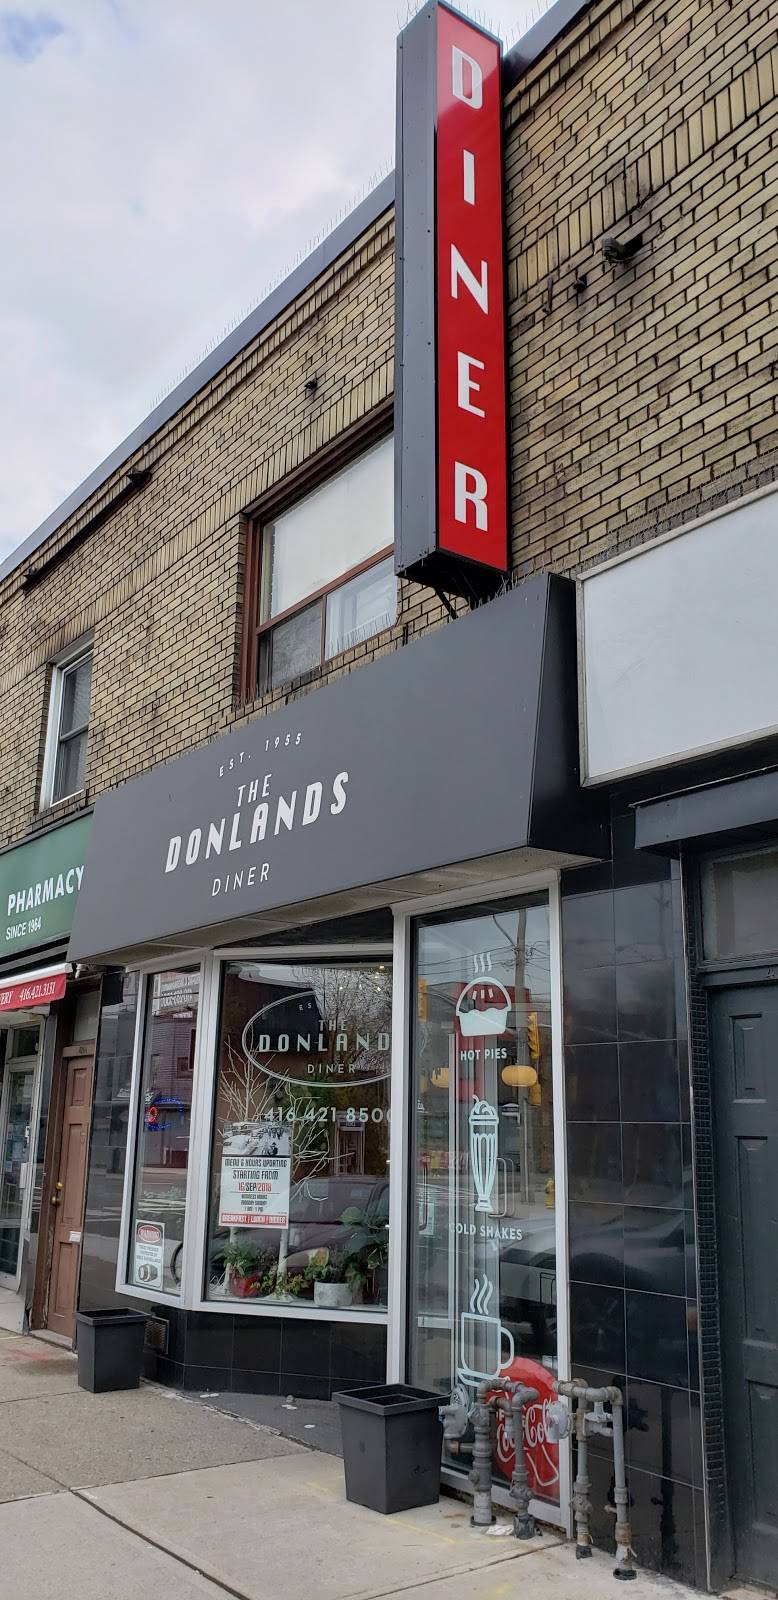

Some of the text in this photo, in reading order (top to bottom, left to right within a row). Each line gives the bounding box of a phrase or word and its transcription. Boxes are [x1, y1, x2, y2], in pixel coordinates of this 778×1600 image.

[449, 44, 489, 533] DINER
[219, 732, 302, 777] EST. 1955
[237, 773, 272, 807] THE
[164, 771, 349, 873] DONLANDS
[211, 862, 270, 897] DINER
[7, 865, 85, 916] PHARMACY
[5, 916, 42, 941] SINCE 1964
[0, 990, 14, 1005] ERY
[318, 1019, 348, 1032] THE
[460, 1048, 507, 1061] HOT PIES
[307, 1063, 356, 1074] DINER
[264, 1106, 296, 1122] 416
[304, 1106, 337, 1122] 421
[232, 1169, 279, 1180] STARTING FROM
[449, 1223, 523, 1241] COLD SHAKES
